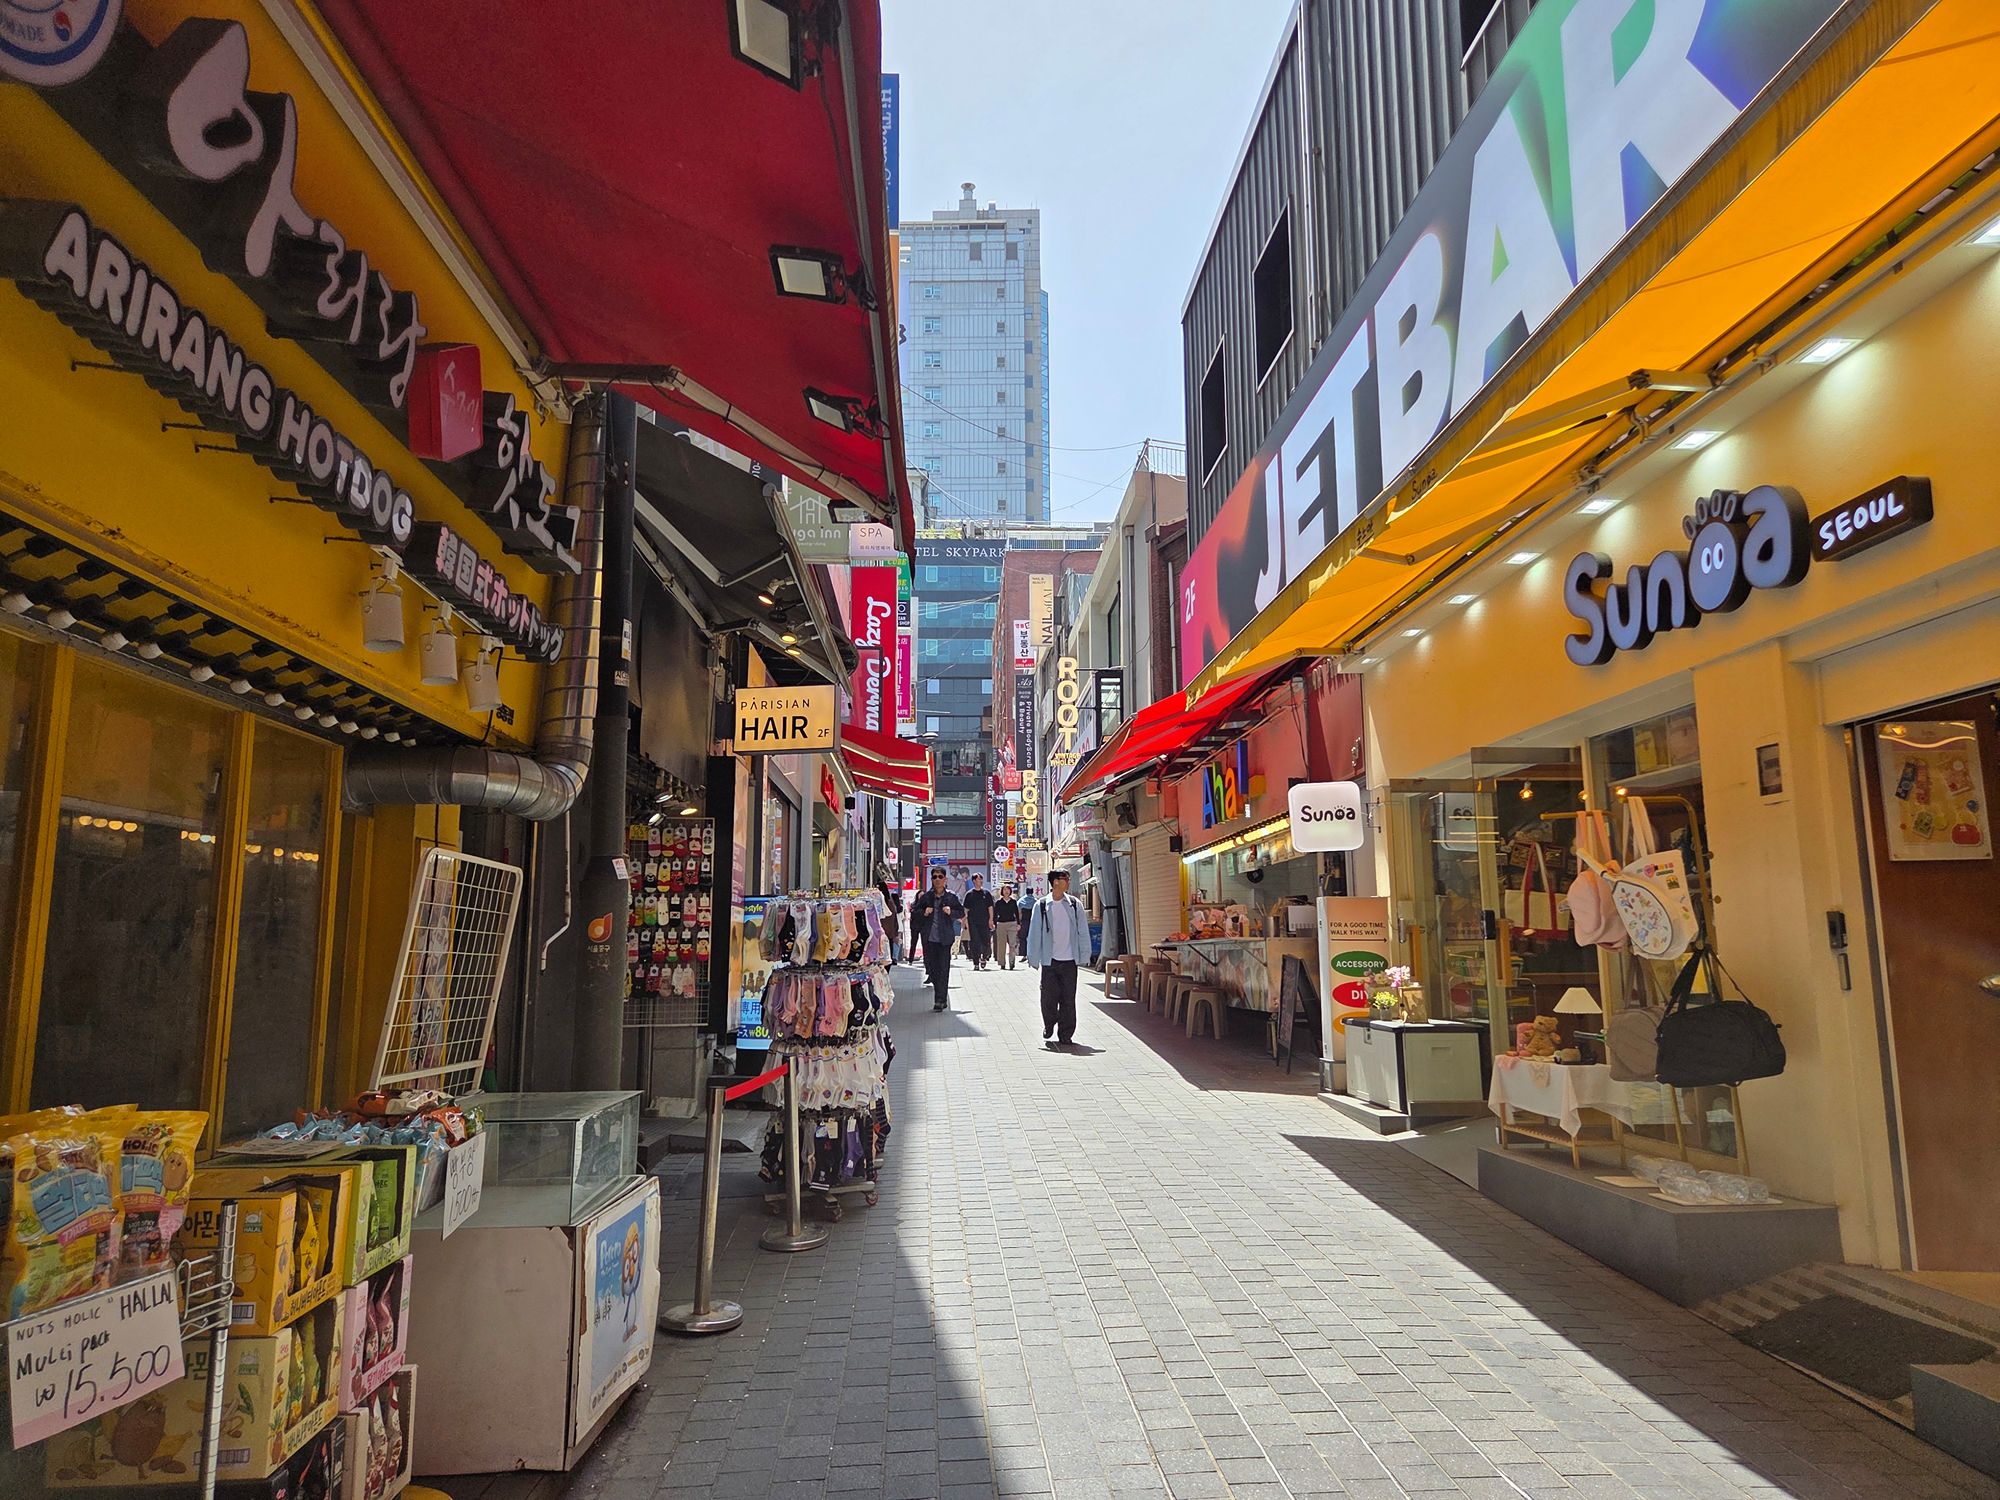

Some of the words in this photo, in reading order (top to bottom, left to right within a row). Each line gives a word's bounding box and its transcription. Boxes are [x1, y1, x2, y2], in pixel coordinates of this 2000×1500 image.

[1255, 0, 1742, 612] JETBAR
[44, 211, 272, 431] ARIRANG
[279, 396, 415, 541] HOTDOG
[820, 526, 841, 538] inn
[859, 527, 883, 538] SPA
[1818, 491, 1905, 551] SEOUL
[916, 547, 939, 557] TEL
[945, 547, 1006, 557] SKYPARK
[1565, 484, 1806, 666] Sunoa
[1183, 579, 1198, 625] 2F
[854, 595, 892, 648] Lazy
[1020, 630, 1029, 658] 부동산
[1025, 700, 1033, 726] Private
[1057, 656, 1079, 752] ROOT
[740, 715, 809, 742] HAIR
[817, 728, 831, 739] 2F
[1022, 769, 1038, 837] ROOT
[1300, 805, 1356, 823] Sunoa
[1335, 960, 1385, 968] ACCESSORY
[16, 1321, 55, 1341] NUTS
[64, 1306, 101, 1328] HOLIC
